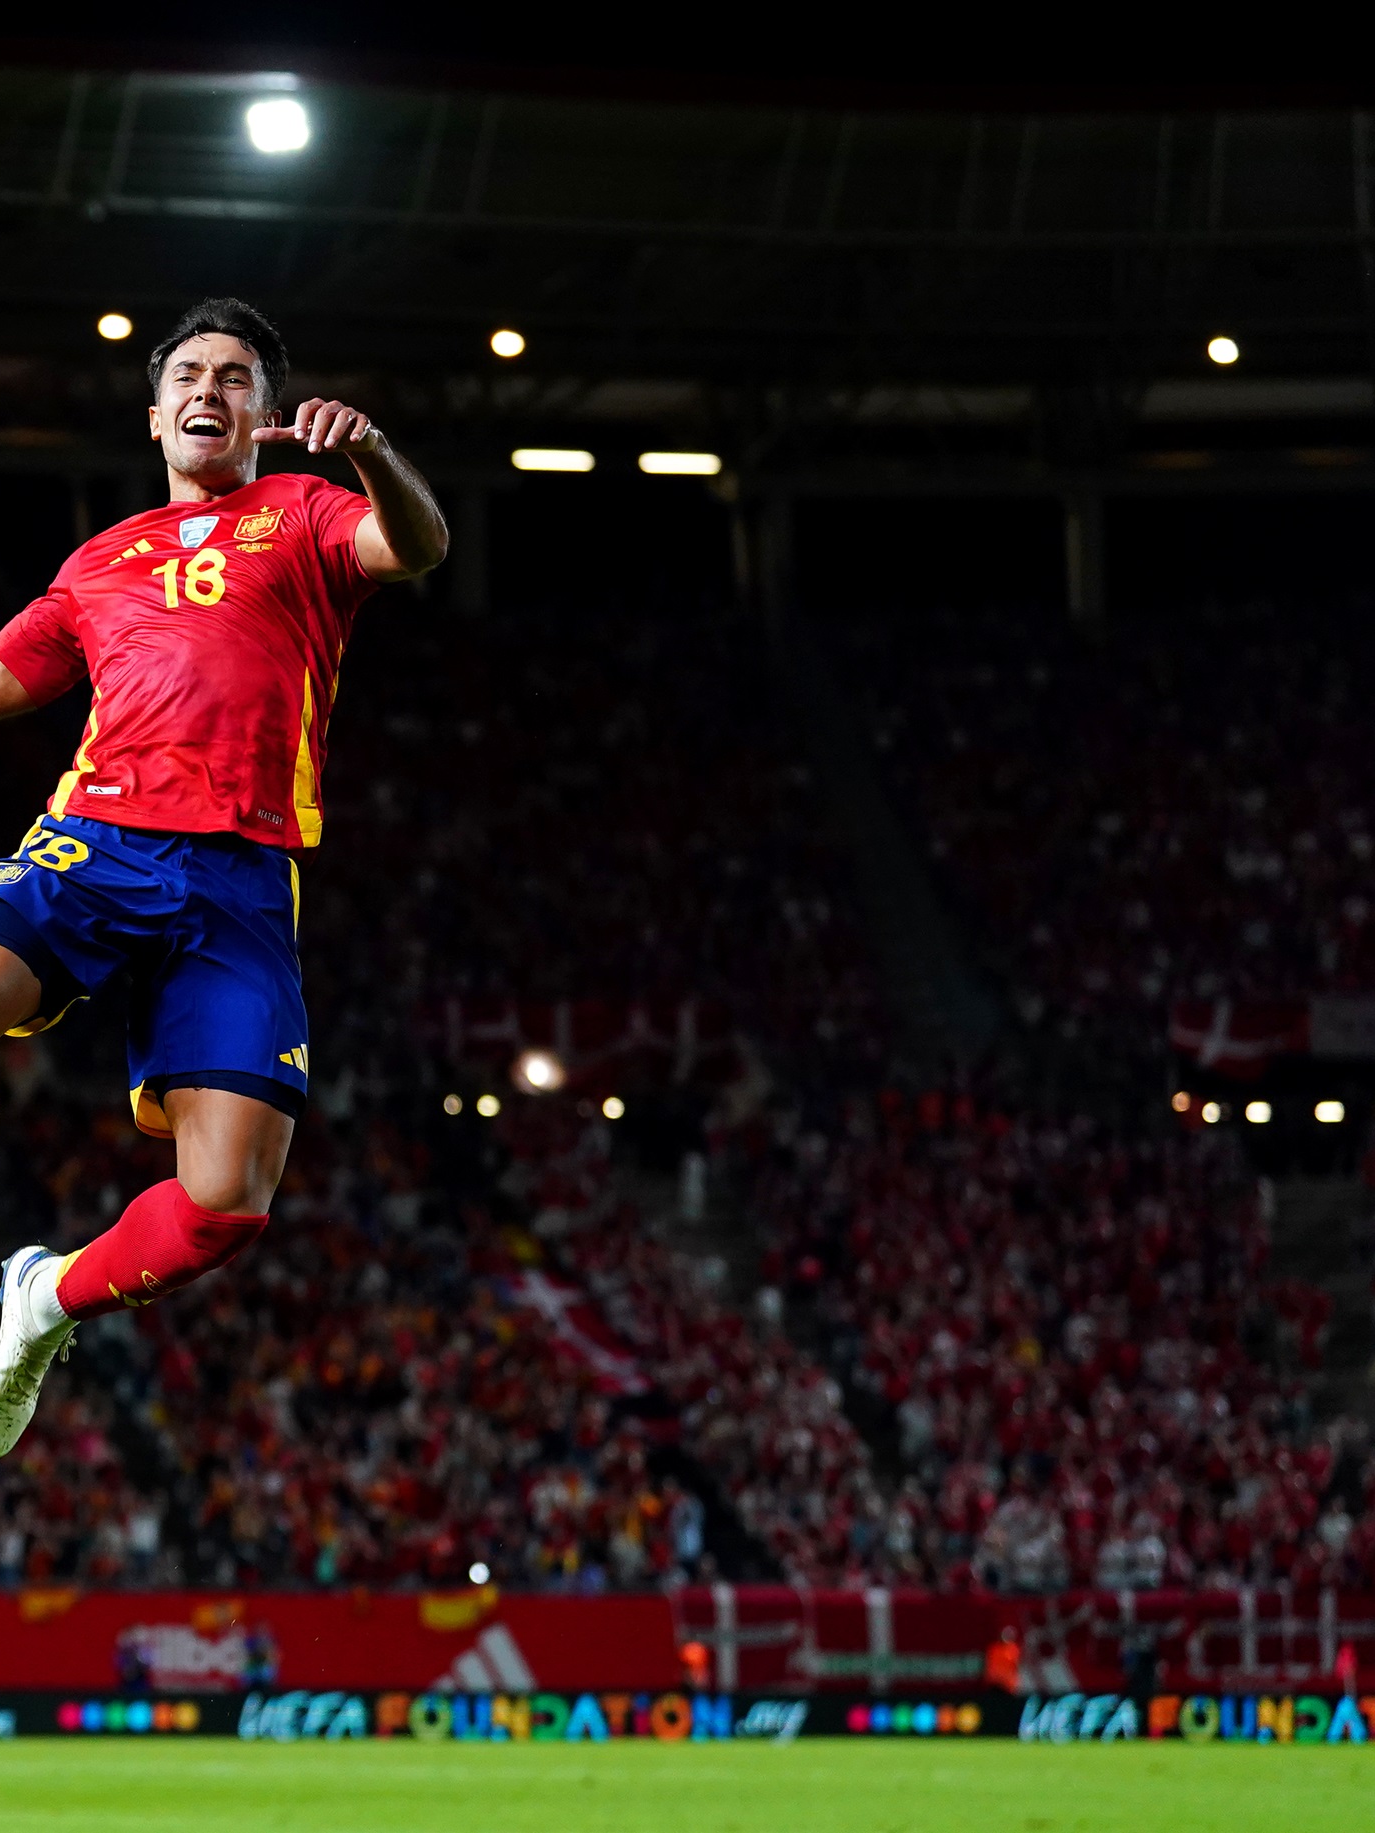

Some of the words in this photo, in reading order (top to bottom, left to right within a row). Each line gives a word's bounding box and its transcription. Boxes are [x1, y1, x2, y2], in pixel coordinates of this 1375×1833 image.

[152, 549, 226, 608] 18
[237, 1691, 368, 1742] UEFA
[373, 1691, 733, 1743] FOUNDATION
[1018, 1692, 1140, 1743] UEFA
